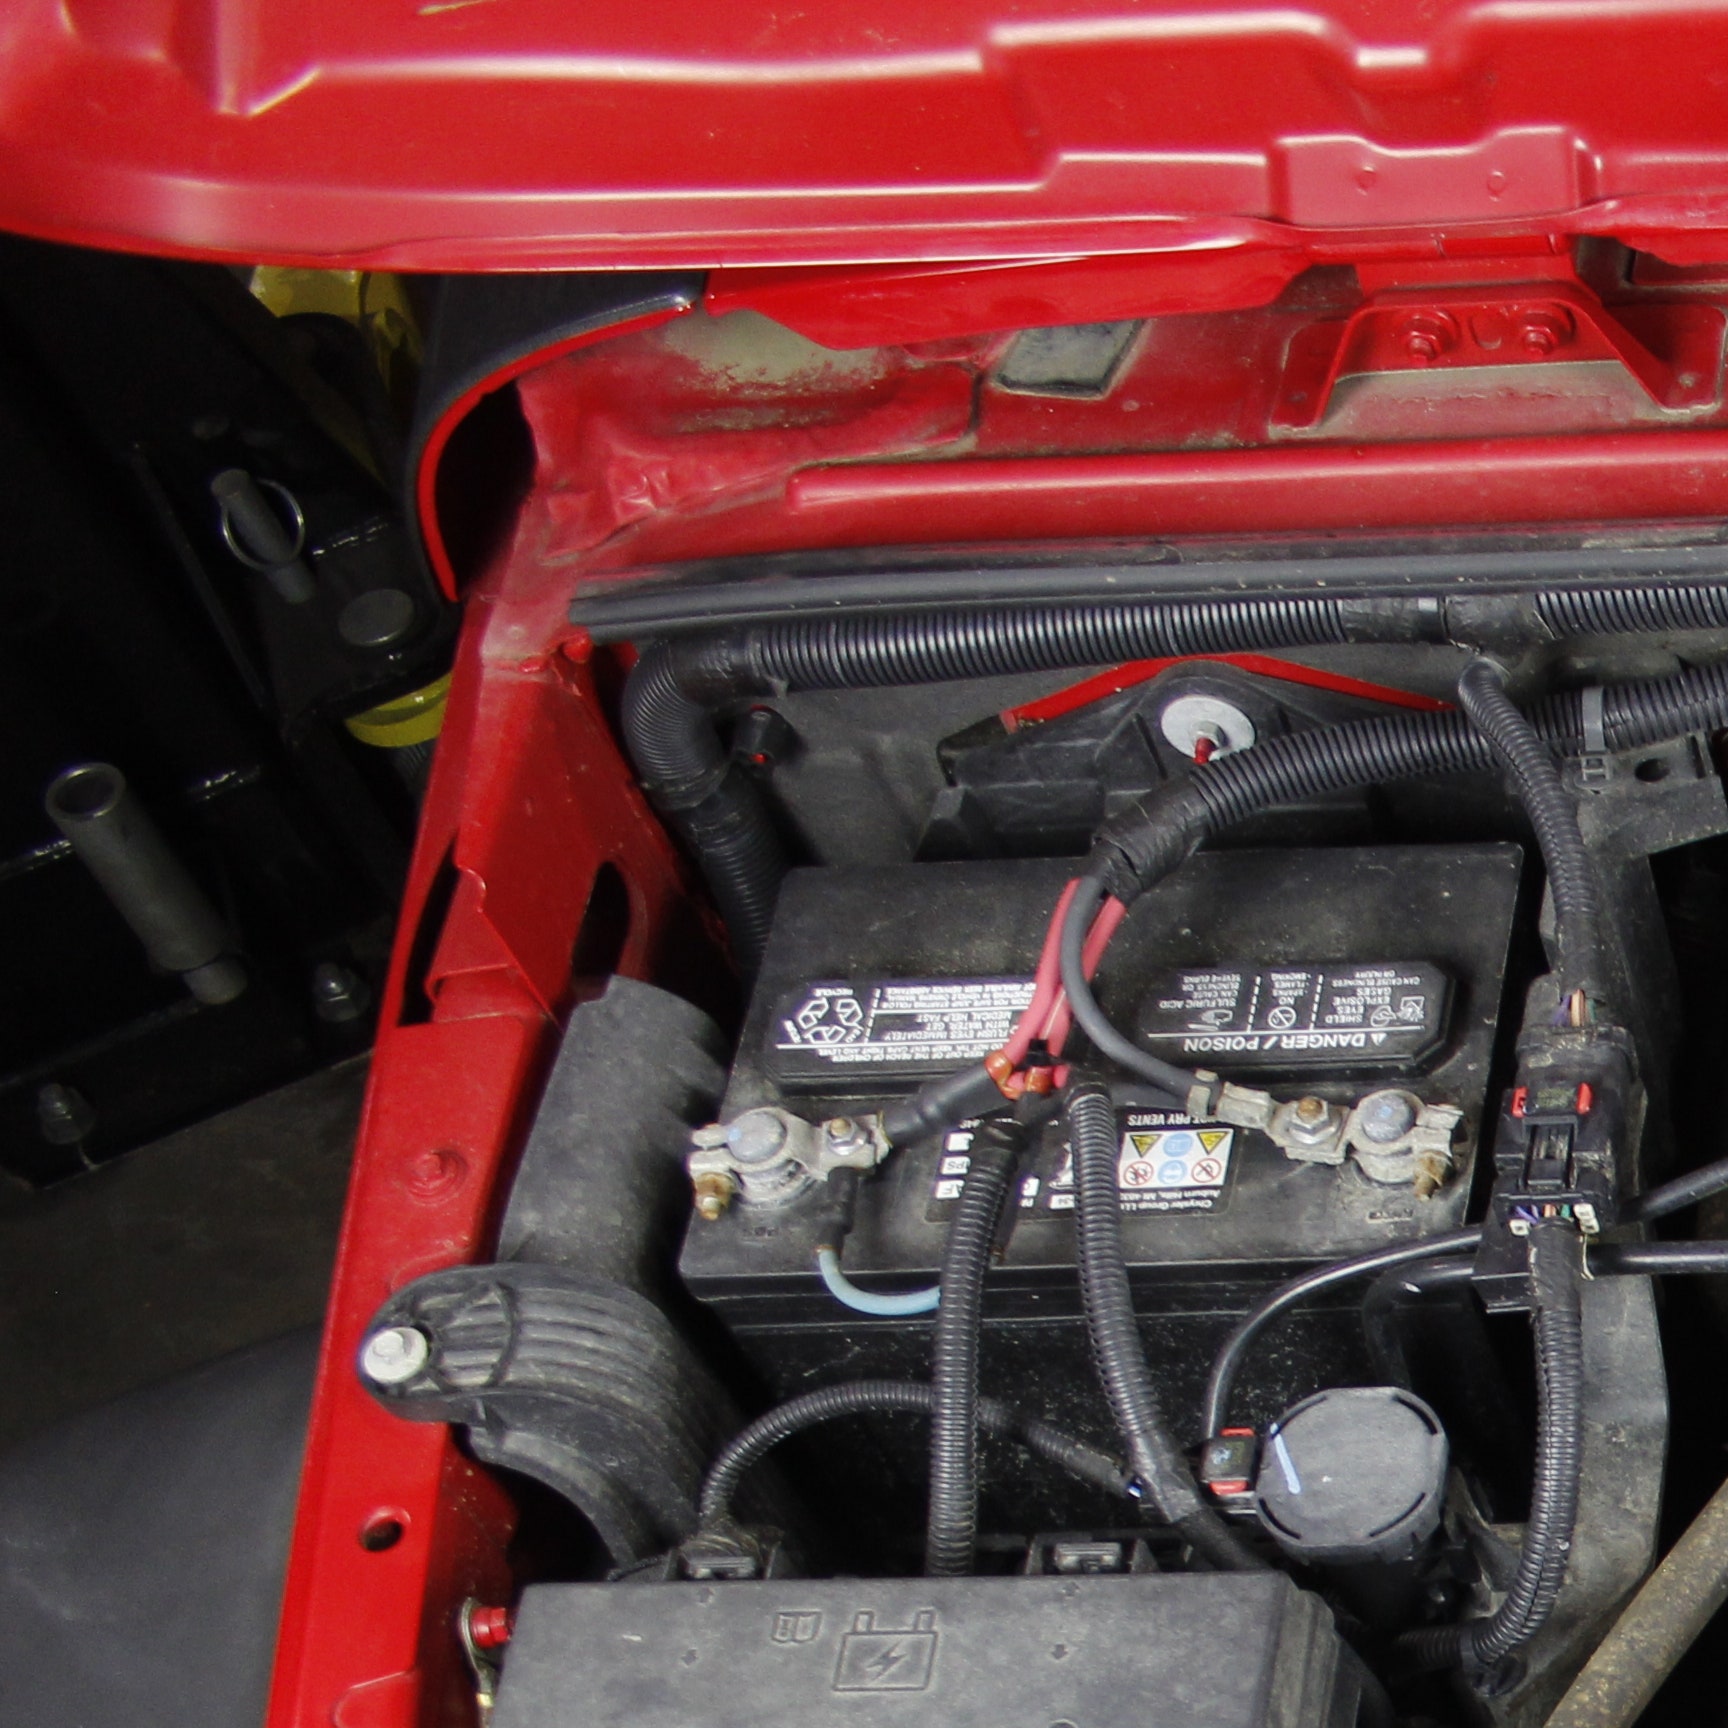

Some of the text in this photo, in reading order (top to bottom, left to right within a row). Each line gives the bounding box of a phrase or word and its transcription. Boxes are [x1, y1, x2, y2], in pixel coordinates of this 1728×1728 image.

[1357, 987, 1392, 996] GASES
[1160, 998, 1236, 1008] SULFURIC ACID
[1279, 997, 1294, 1005] NO
[1333, 996, 1390, 1006] EXPLOSIVE
[1337, 1006, 1364, 1014] EYES
[917, 1011, 1012, 1022] MEDICAL HELP FAST
[1326, 1014, 1362, 1024] SHIELD
[926, 1023, 945, 1031] GET
[986, 1021, 1010, 1030] WITH
[885, 1028, 1008, 1041] FLUSH EYES IMMEDIATELY
[1184, 1033, 1365, 1051] DANGER / POISON
[1127, 1114, 1164, 1126] VENTS
[1167, 1114, 1191, 1125] PRY
[1184, 1189, 1220, 1199] Auburn
[1120, 1198, 1212, 1210] Chrysler Group LL
